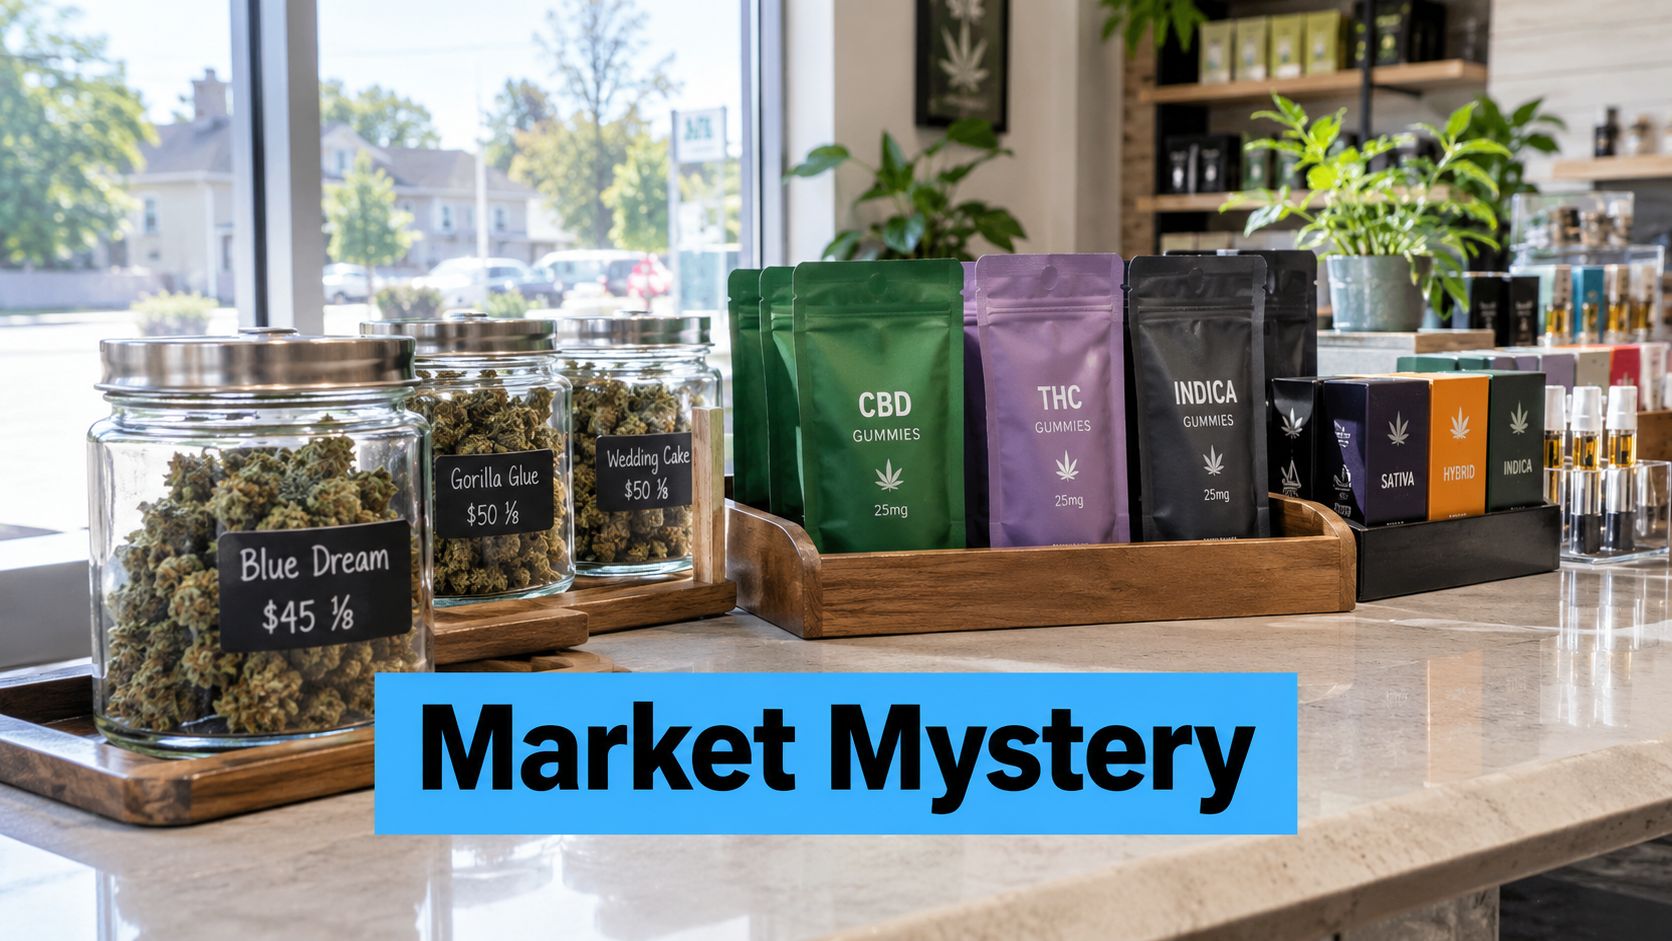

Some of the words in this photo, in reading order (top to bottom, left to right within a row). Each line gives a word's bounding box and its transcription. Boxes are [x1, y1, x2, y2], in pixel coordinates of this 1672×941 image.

[1037, 384, 1083, 411] THC
[1173, 379, 1238, 405] INDICA
[858, 390, 912, 418] CBD
[1034, 419, 1092, 434] GUMMIES
[1183, 414, 1234, 428] GUMMIES
[852, 427, 921, 443] GUMMIES
[606, 446, 659, 476] Wedding
[662, 444, 691, 465] Cake
[1503, 458, 1533, 476] INDICA
[450, 466, 503, 490] Gorilla
[508, 464, 540, 487] Glue
[1381, 471, 1415, 489] SATIVA
[1443, 464, 1476, 482] HYBRID
[624, 479, 651, 501] $50
[1203, 488, 1230, 503] 25mg
[874, 503, 908, 519] 25mg
[1055, 494, 1084, 509] 25mg
[466, 502, 498, 527] $50
[239, 546, 300, 582] Blue
[311, 544, 390, 577] Dream
[262, 599, 316, 635] $45
